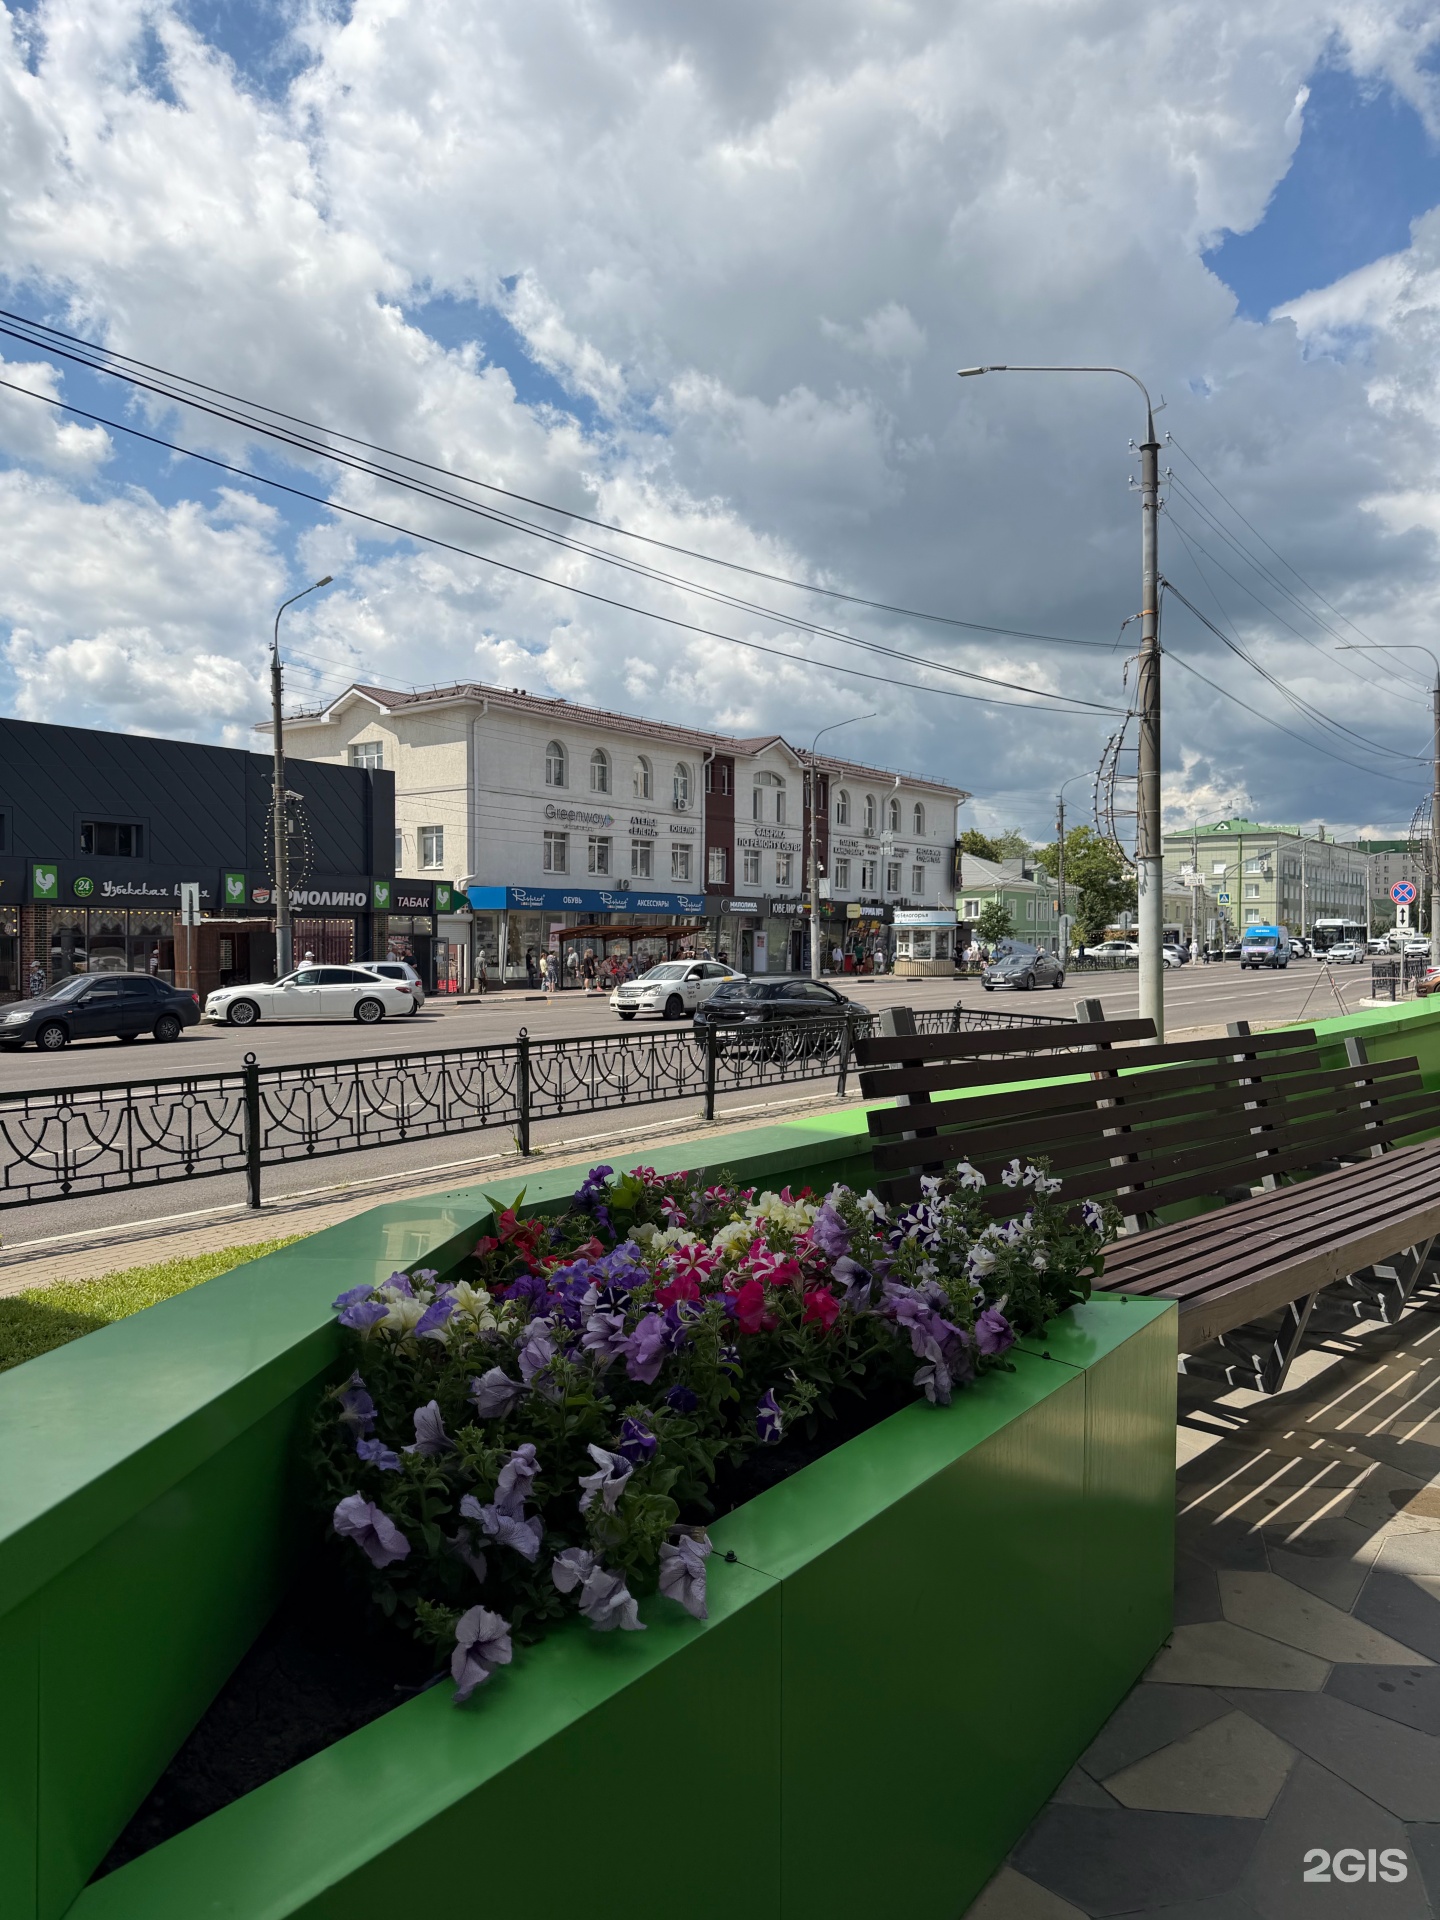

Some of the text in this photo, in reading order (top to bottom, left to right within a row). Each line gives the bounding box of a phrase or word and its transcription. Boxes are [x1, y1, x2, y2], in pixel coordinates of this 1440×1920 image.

[544, 803, 607, 828] Greenway
[754, 827, 786, 840] ФАБРИКА
[737, 837, 802, 852] ПО РЕМОНТУ ОБУВИ
[78, 880, 90, 891] 24
[100, 880, 169, 898] Узбекская
[397, 896, 430, 908] ТАБАК
[562, 896, 583, 904] ОБУВЬ
[636, 899, 670, 908] АКСЕССУАРЫ
[772, 903, 796, 914] ЮВЕЛИР
